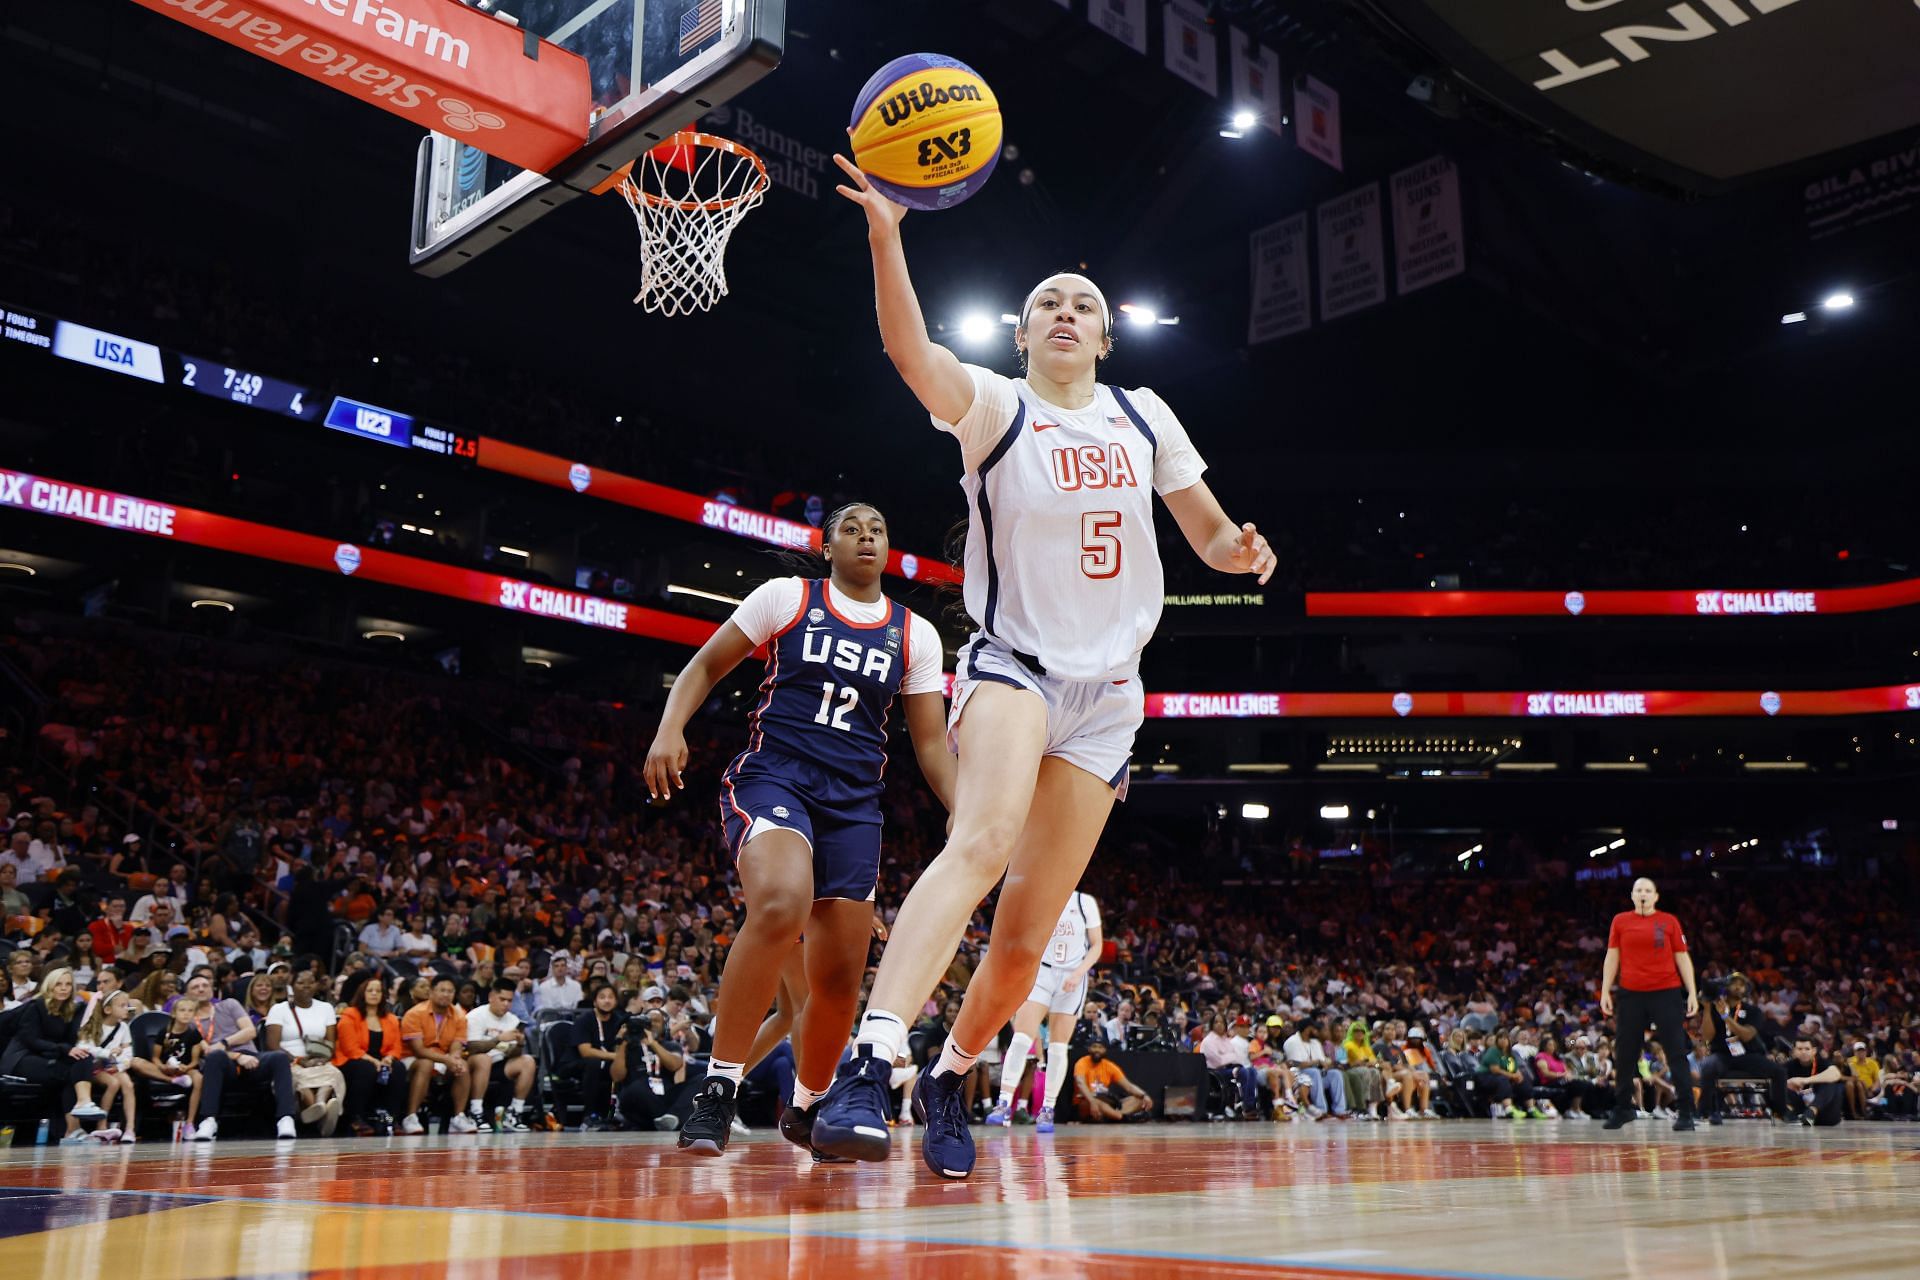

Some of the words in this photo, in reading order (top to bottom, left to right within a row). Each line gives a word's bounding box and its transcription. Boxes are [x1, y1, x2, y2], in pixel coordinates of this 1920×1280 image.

[303, 0, 470, 69] eFarm
[877, 82, 982, 127] Wilson
[736, 108, 830, 172] Banner
[923, 168, 954, 181] OFFICIAL
[955, 163, 970, 174] BALL
[1396, 158, 1451, 192] PHOENIX
[1408, 180, 1441, 206] SUNS
[6, 311, 37, 329] FOULS
[5, 326, 51, 348] TIMEOUTS
[95, 338, 134, 367] USA
[182, 363, 197, 387] 2
[223, 367, 263, 397] 7:49
[290, 393, 304, 414] 4
[356, 408, 392, 437] U23
[455, 437, 476, 458] 2.5
[1052, 442, 1138, 491] USA
[31, 480, 175, 536] CHALLENGE
[703, 501, 727, 530] 3X
[728, 510, 812, 547] CHALLENGE
[1081, 510, 1122, 580] 5
[500, 580, 526, 602] 3X
[529, 586, 628, 630] CHALLENGE
[1213, 594, 1241, 606] WITH
[1242, 594, 1264, 606] THE
[1696, 593, 1720, 613] 3X
[1722, 592, 1816, 613] CHALLENGE
[802, 632, 893, 684] USA
[814, 681, 860, 732] 12
[1163, 696, 1186, 715] 3X
[1189, 695, 1280, 715] CHALLENGE
[1527, 694, 1551, 714] 3X
[1553, 694, 1646, 714] CHALLENGE
[1905, 686, 1920, 708] 3
[1053, 920, 1075, 937] SA
[1054, 941, 1067, 963] 9
